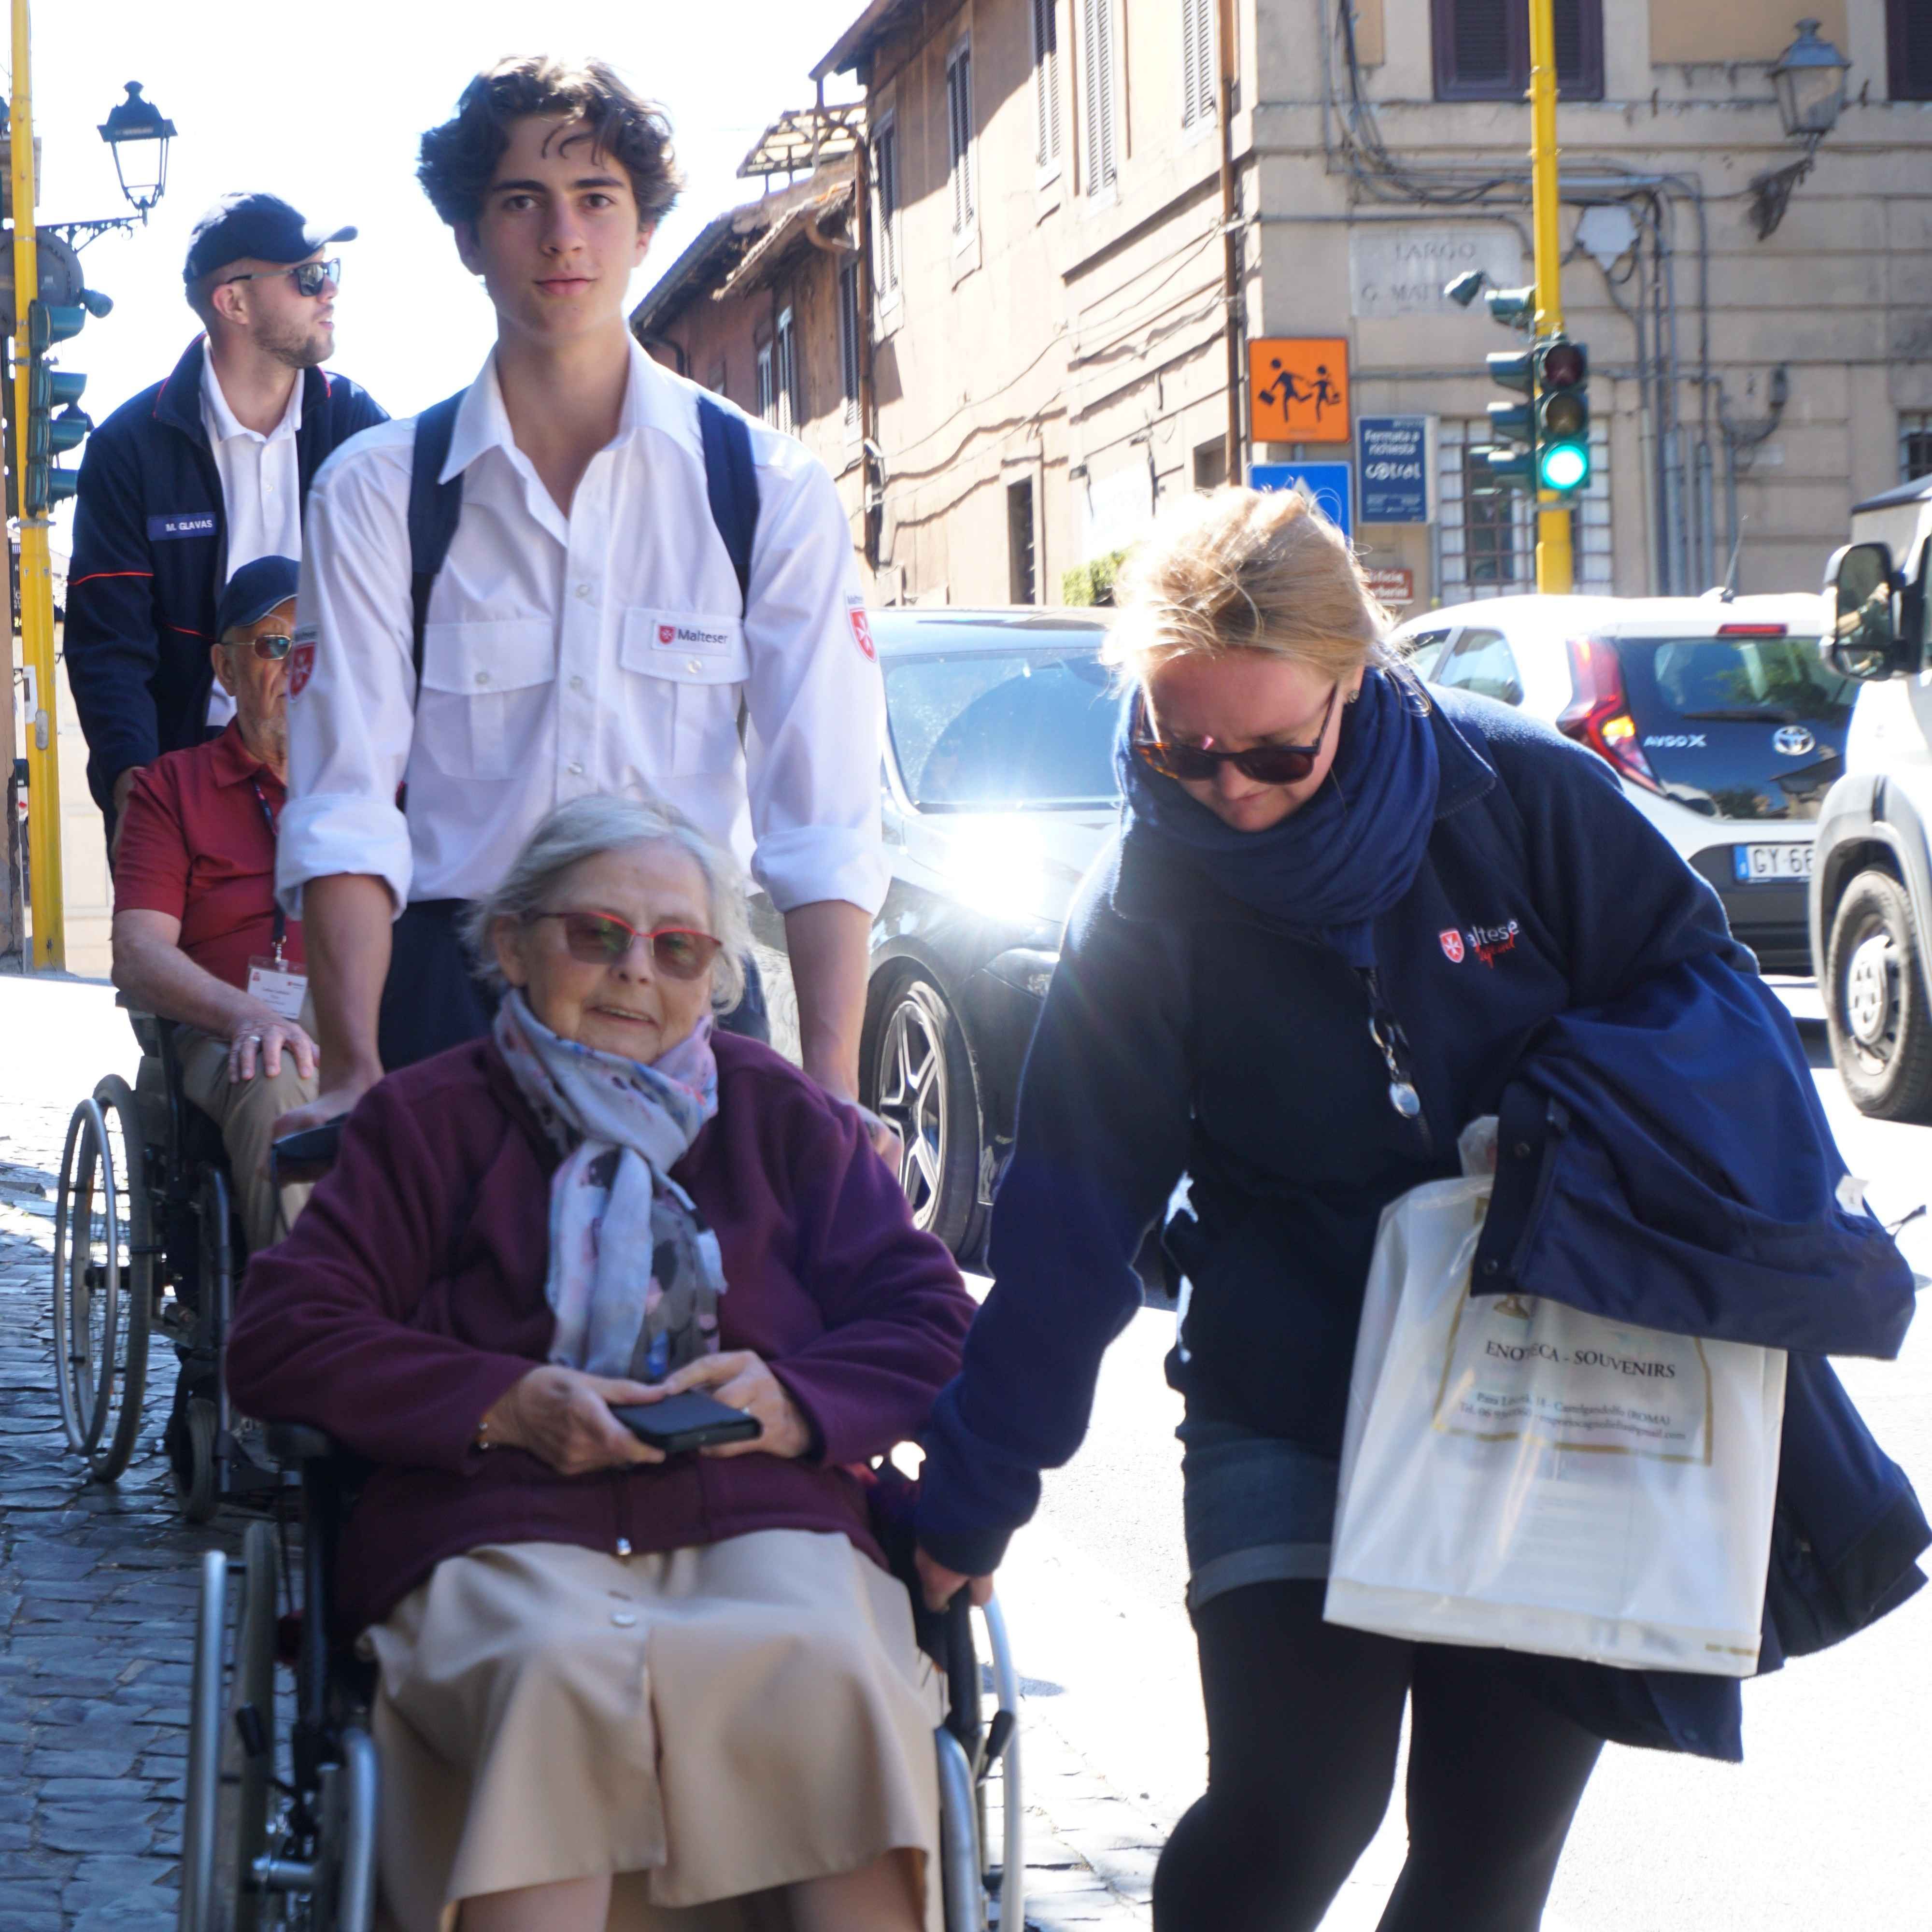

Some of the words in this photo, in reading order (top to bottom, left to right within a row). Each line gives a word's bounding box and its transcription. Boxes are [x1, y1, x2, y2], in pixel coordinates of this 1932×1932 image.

[1395, 242, 1475, 260] LARGO
[178, 520, 213, 530] GLAVAS
[677, 629, 728, 644] Malteser
[1486, 1340, 1560, 1362] ENOTECA
[1573, 1350, 1676, 1378] SOUVENIRS
[1628, 1409, 1671, 1426] (ROMA)
